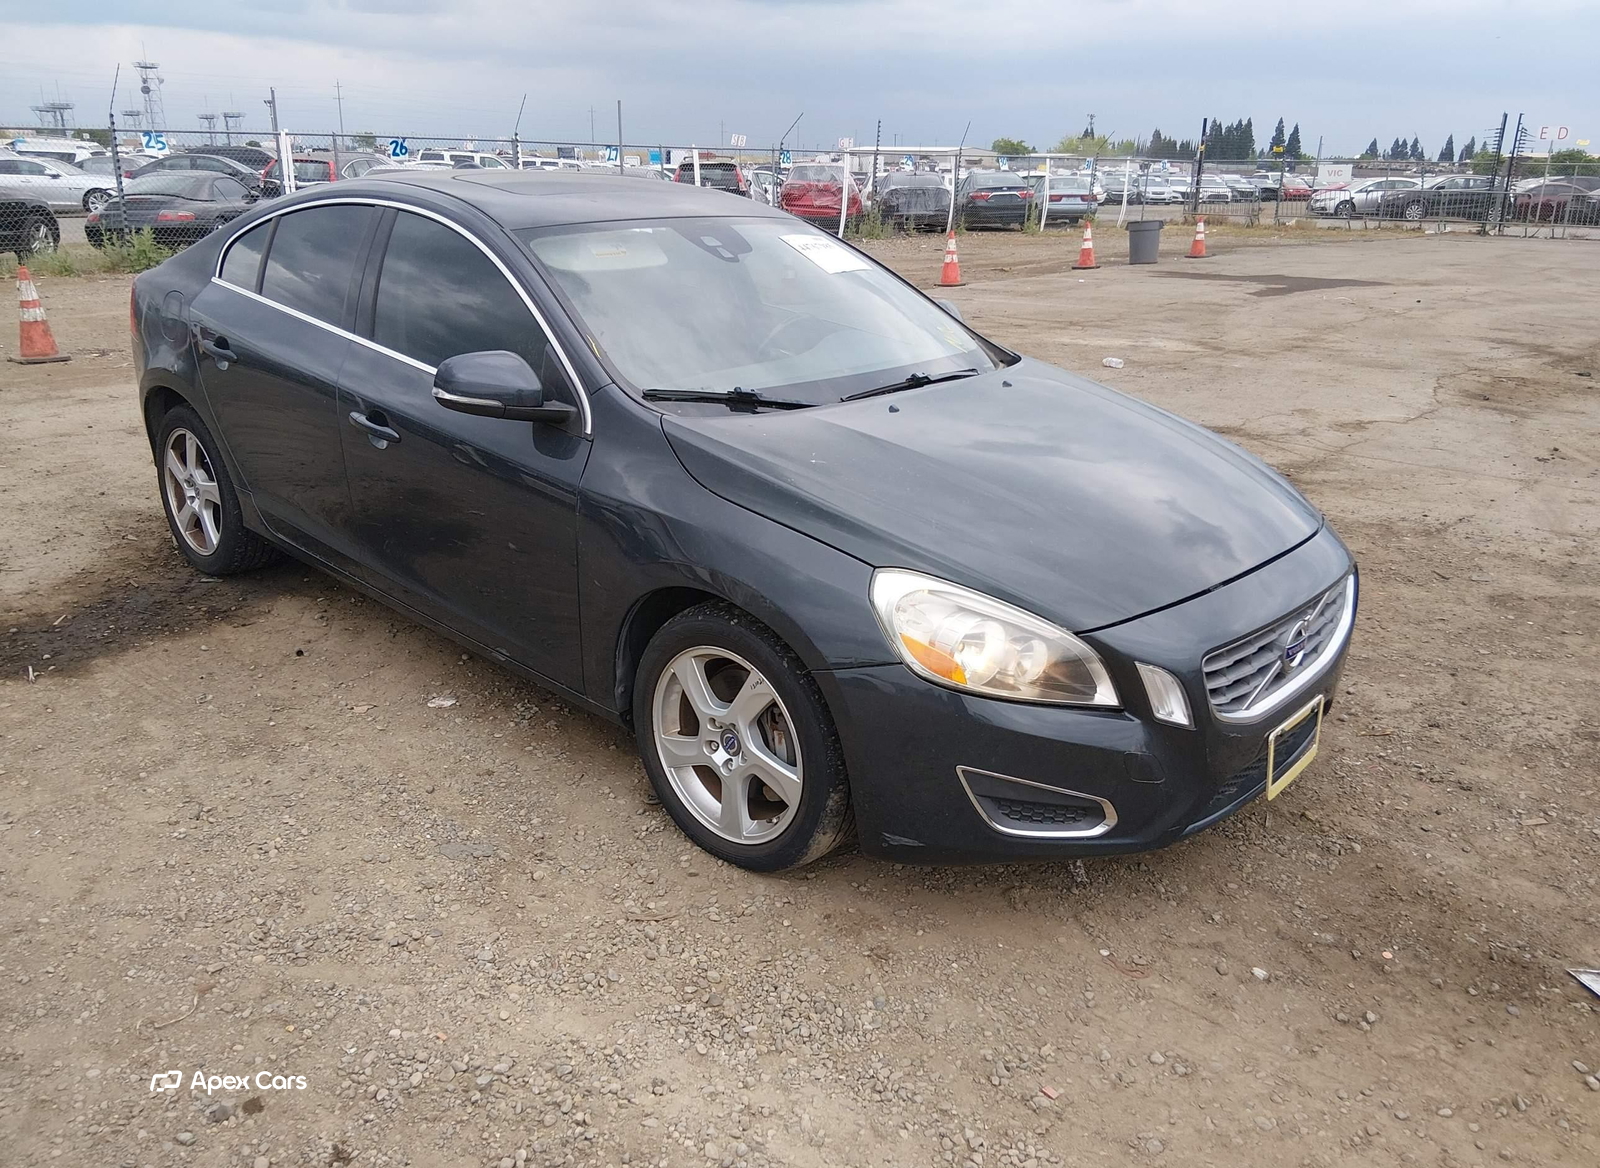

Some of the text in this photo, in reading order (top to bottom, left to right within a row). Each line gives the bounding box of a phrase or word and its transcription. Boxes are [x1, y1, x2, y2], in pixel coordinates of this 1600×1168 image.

[1540, 126, 1569, 140] E D
[142, 131, 167, 151] 25
[389, 139, 408, 157] 26
[605, 145, 619, 162] 27
[781, 150, 792, 164] 28
[1327, 169, 1343, 177] VIC
